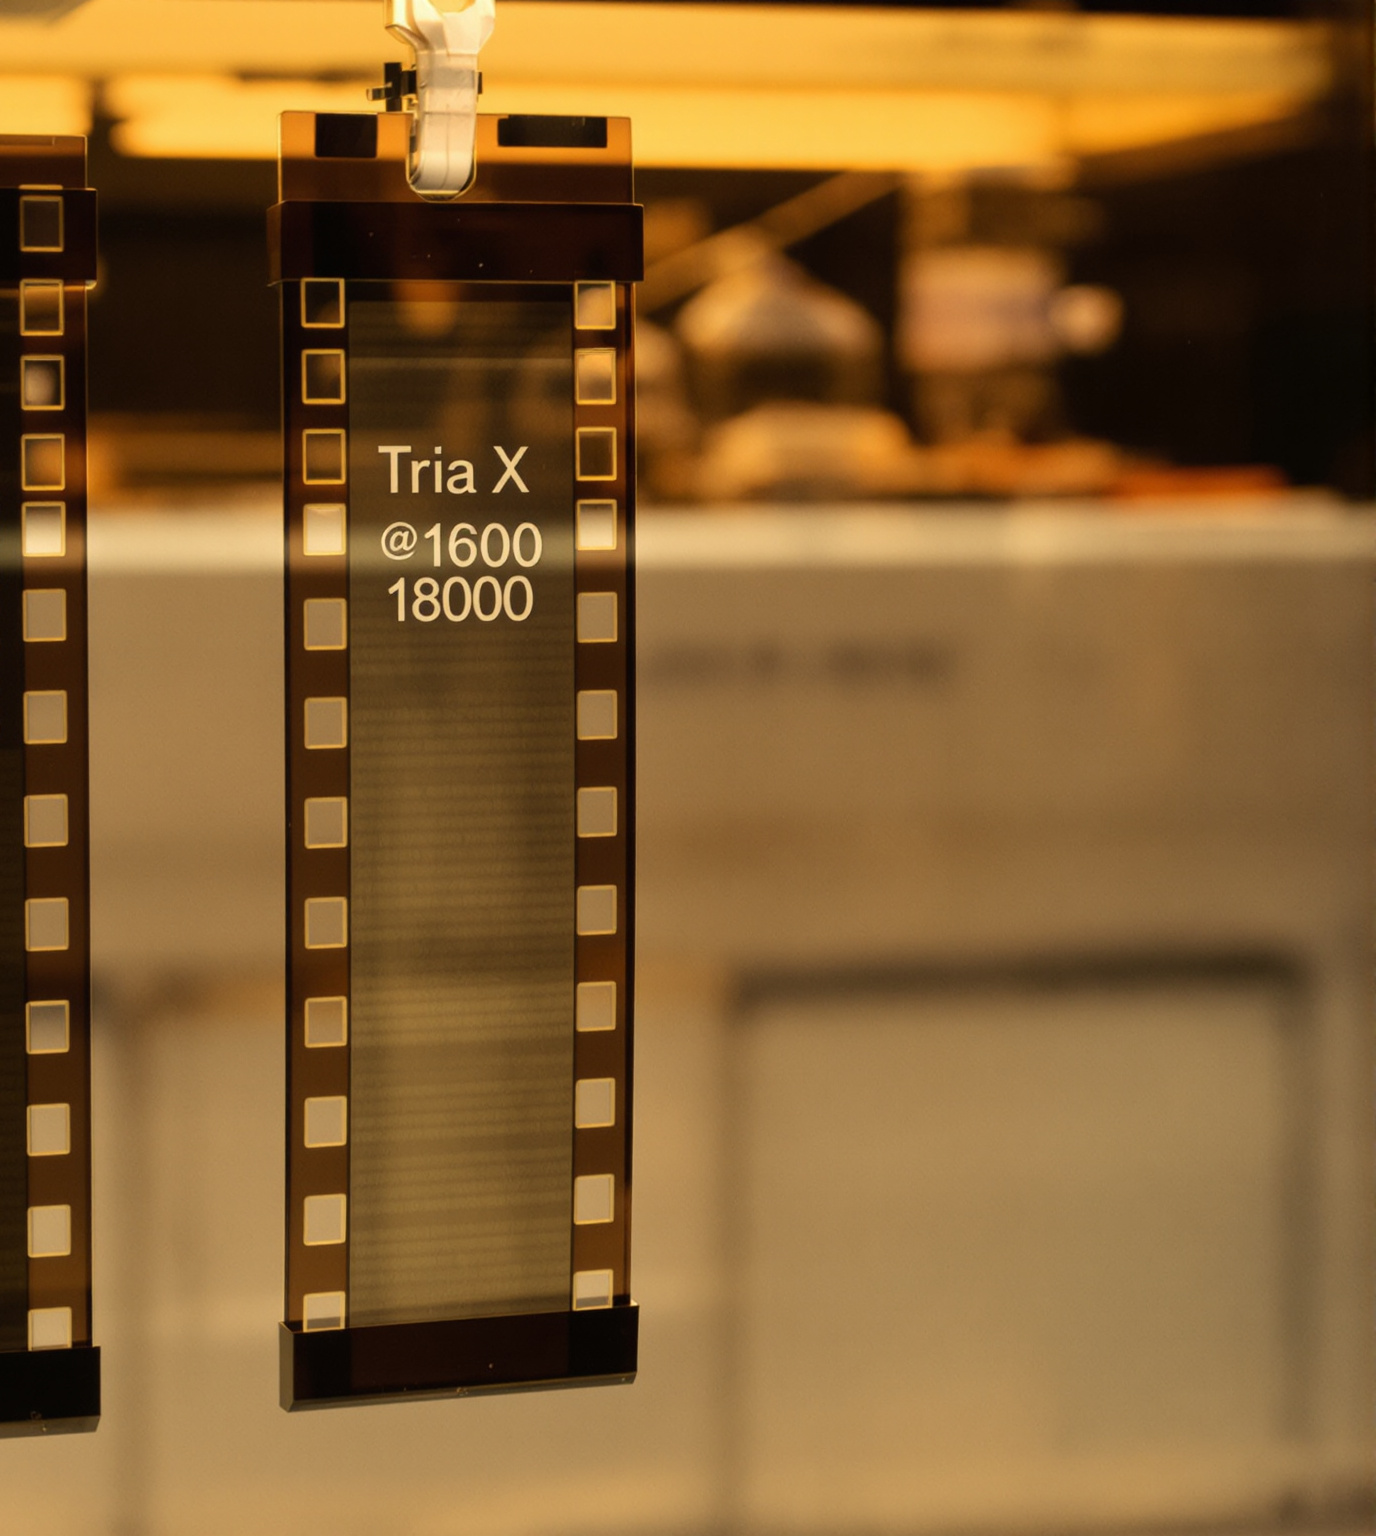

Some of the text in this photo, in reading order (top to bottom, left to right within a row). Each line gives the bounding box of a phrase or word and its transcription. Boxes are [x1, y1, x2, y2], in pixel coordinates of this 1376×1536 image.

[377, 445, 530, 494] Tria X
[388, 575, 534, 622] 18000
